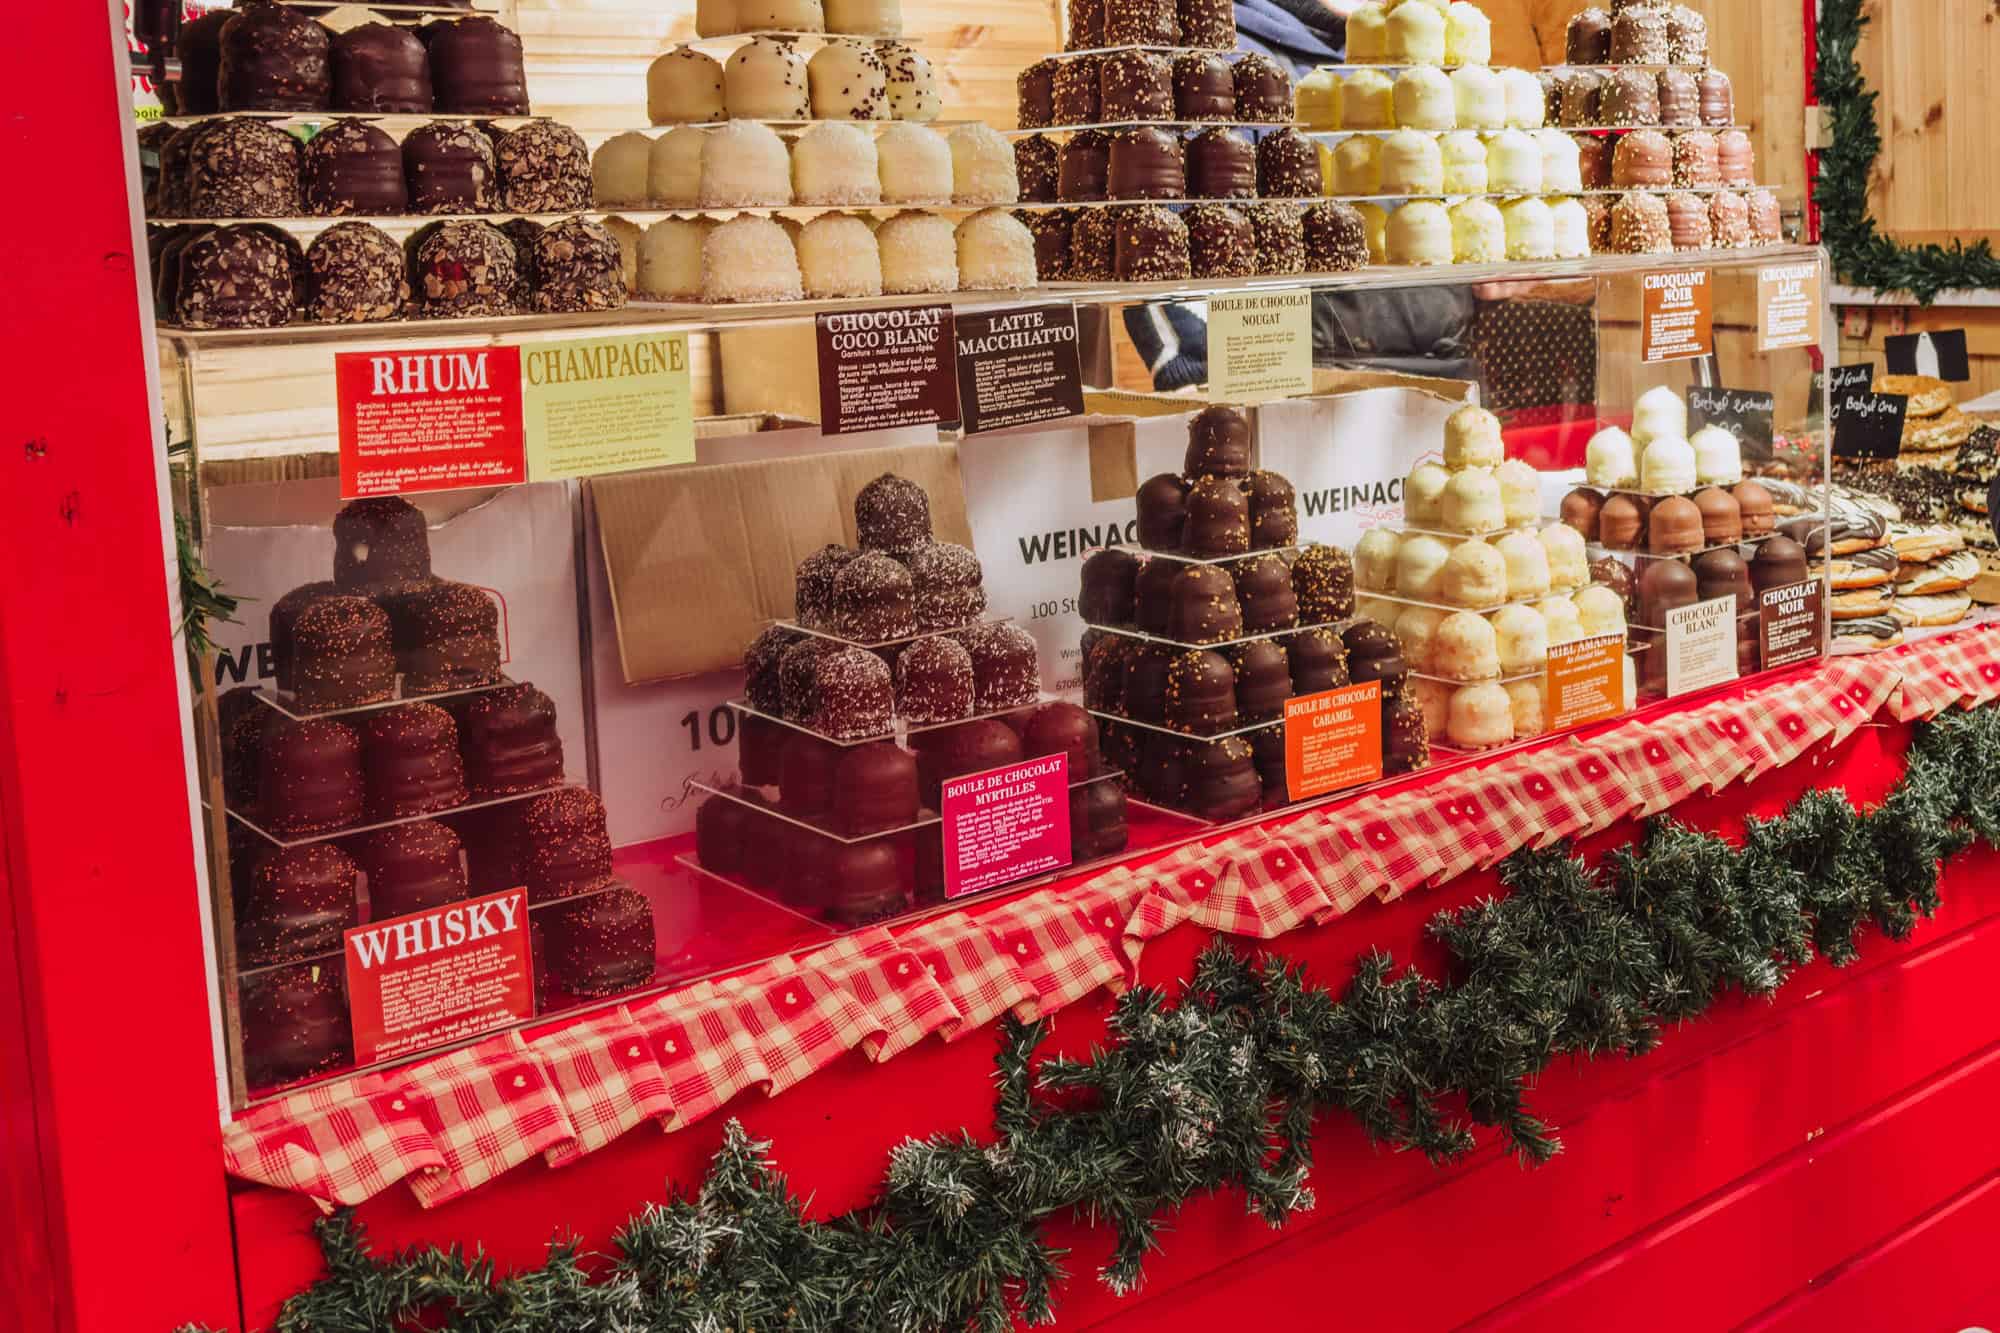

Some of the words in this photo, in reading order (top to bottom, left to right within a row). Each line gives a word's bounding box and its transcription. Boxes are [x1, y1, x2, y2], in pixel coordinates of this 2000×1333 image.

[1644, 271, 1706, 289] CROQUANT
[1211, 298, 1244, 312] BOULE
[1245, 297, 1259, 310] DE
[1260, 294, 1310, 309] CHOCOLAT
[1663, 287, 1694, 303] NOIR
[826, 308, 943, 332] CHOCOLAT
[988, 312, 1045, 333] LATTE
[1242, 312, 1281, 327] NOUGAT
[831, 331, 880, 350] COCO
[884, 327, 940, 346] BLANC
[958, 326, 1075, 356] MACCHIATTO
[370, 352, 490, 396] RHUM
[527, 339, 684, 386] CHAMPAGNE
[1761, 582, 1818, 606] CHOCOLAT
[1031, 600, 1058, 620] 100
[1671, 599, 1731, 626] CHOCOLAT
[1778, 599, 1806, 617] NOIR
[1684, 615, 1720, 635] BLANC
[1287, 701, 1318, 718] BOULE
[1319, 697, 1331, 710] DE
[1332, 687, 1378, 707] CHOCOLAT
[1312, 708, 1355, 728] CARAMEL
[946, 779, 985, 799] BOULE
[987, 774, 1003, 789] DE
[1004, 759, 1062, 786] CHOCOLAT
[975, 781, 1037, 806] MYRTILLES
[351, 894, 521, 969] WHISKY
